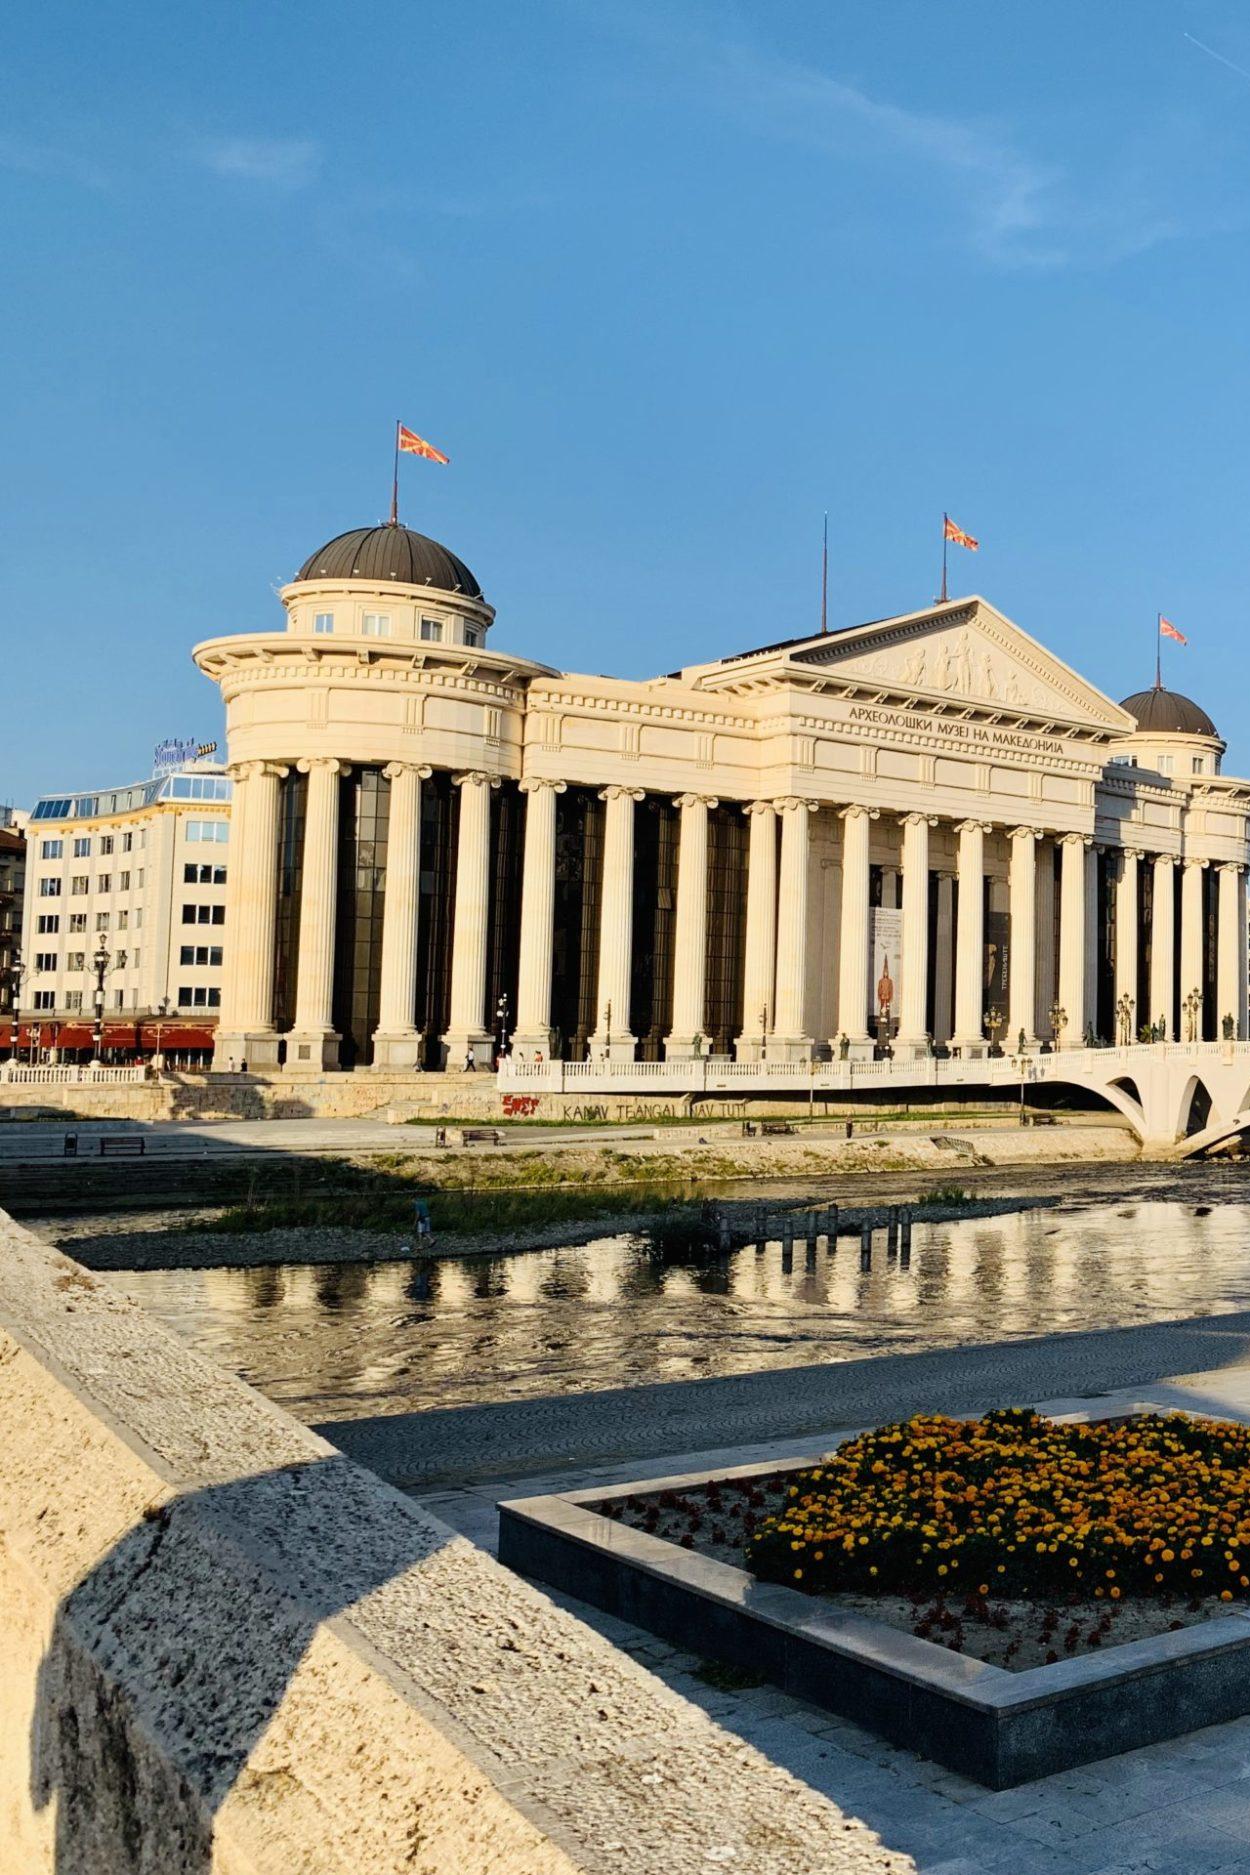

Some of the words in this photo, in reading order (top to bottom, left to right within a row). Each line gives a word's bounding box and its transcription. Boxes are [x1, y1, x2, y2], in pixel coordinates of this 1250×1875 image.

[849, 707, 933, 732] АРХЕОЛОШКИ
[937, 721, 969, 738] МУЗЕЈ
[973, 728, 990, 743] НА
[992, 731, 1064, 754] МАКЕДОНИЈА
